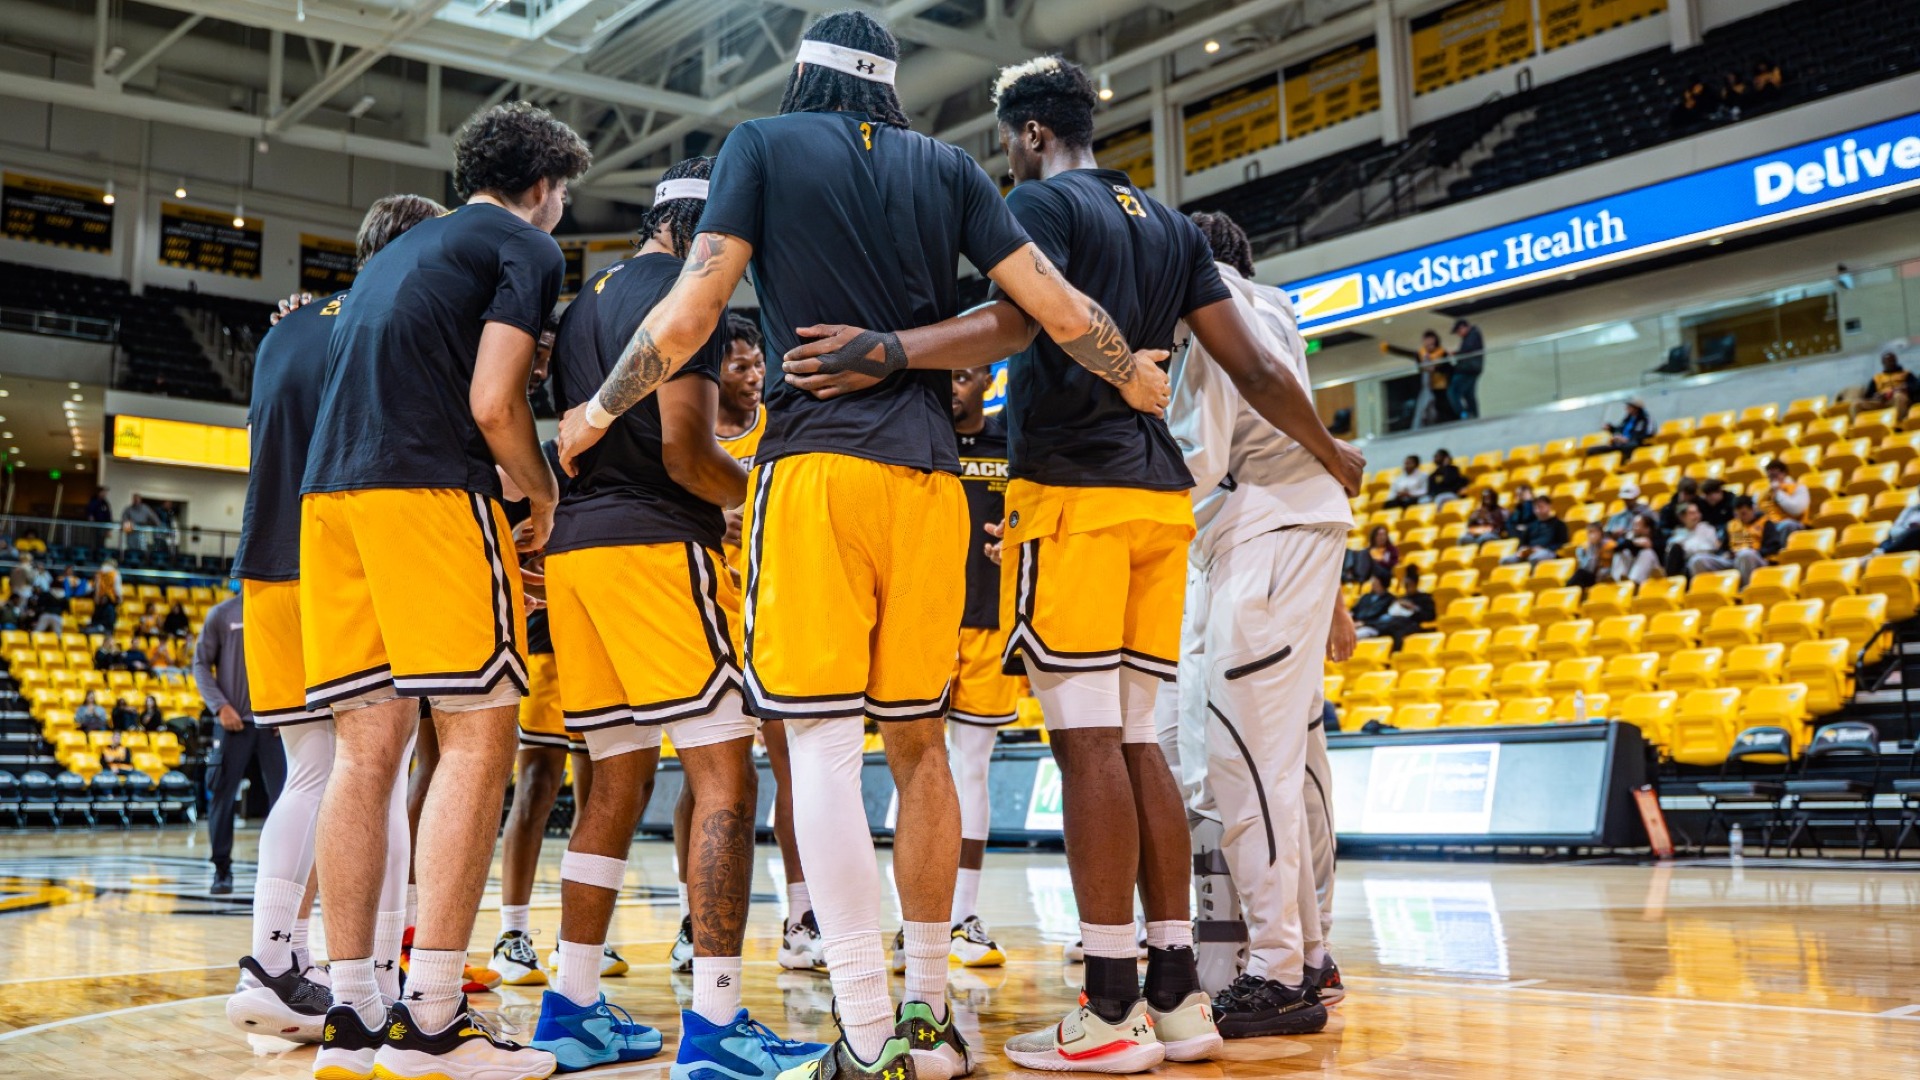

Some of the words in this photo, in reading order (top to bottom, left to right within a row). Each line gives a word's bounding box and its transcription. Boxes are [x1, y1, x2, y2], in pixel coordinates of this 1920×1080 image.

[1754, 136, 1920, 206] Delive
[1367, 248, 1498, 304] MedStar
[1503, 209, 1627, 270] Health
